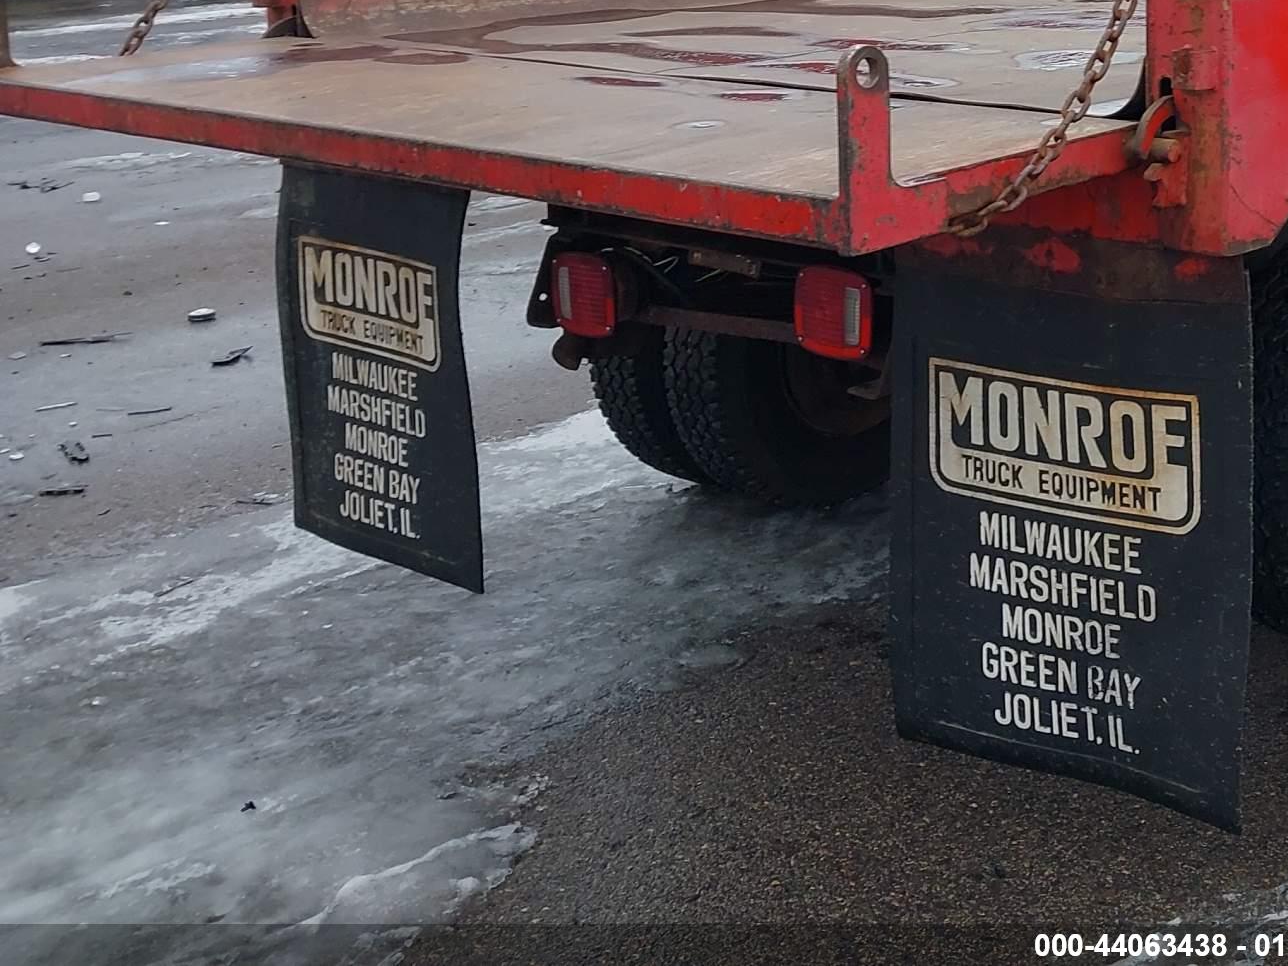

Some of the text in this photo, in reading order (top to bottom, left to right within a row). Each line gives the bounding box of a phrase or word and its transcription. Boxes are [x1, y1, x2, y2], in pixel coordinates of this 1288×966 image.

[304, 246, 434, 325] MONROE
[321, 310, 425, 356] TRUCK EQUIPMENT
[331, 351, 418, 402] MILWAUKEE
[327, 384, 426, 438] MARSHFIELD
[938, 370, 1188, 474] MONROE
[345, 422, 409, 468] MONROE
[334, 452, 421, 505] GREEN BAY
[961, 454, 1162, 513] TRUCK EQUIPMENT
[400, 507, 421, 539] IL.
[979, 510, 1142, 575] MILWAUKEE
[969, 552, 1157, 623] MARSHFIELD
[1002, 603, 1121, 659] MONROE
[981, 641, 1142, 711] GREEN BAY
[1107, 714, 1141, 755] IL.
